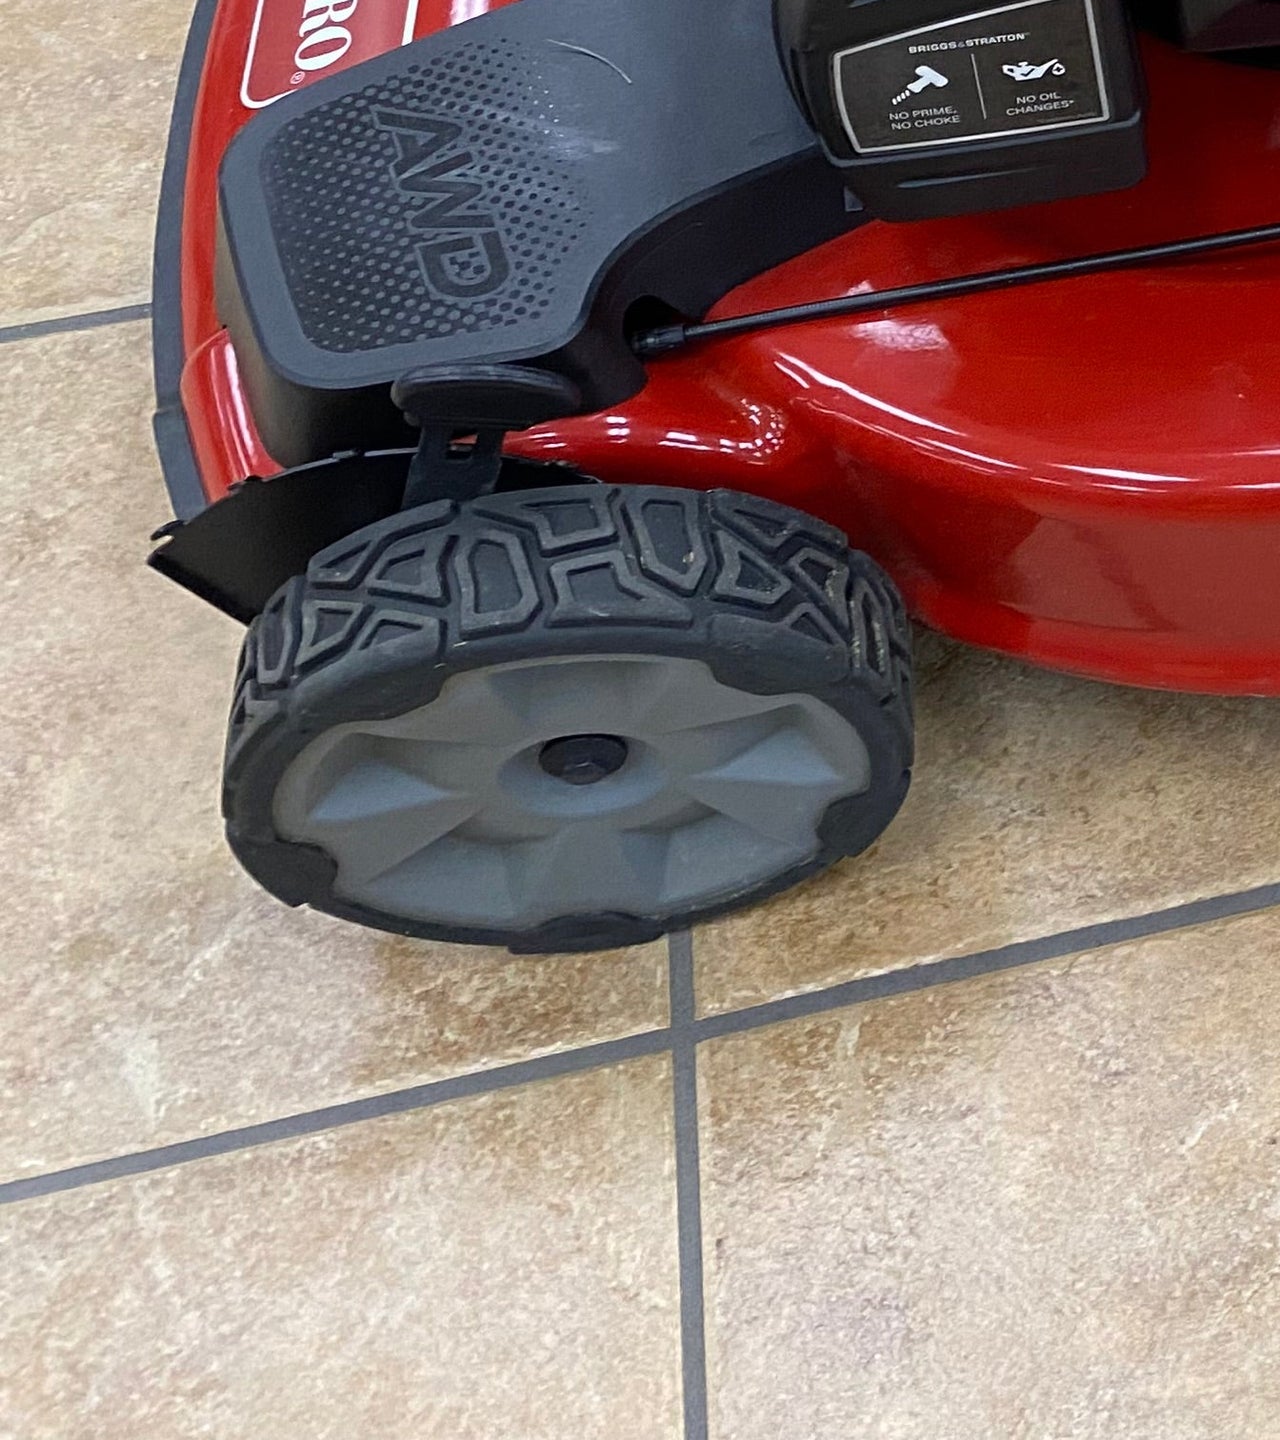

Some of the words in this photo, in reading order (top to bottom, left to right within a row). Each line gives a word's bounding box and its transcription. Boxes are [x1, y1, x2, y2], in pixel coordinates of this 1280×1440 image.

[1016, 94, 1037, 105] NO
[1039, 91, 1062, 102] OIL
[889, 110, 910, 122] NO
[891, 120, 912, 131] NO
[913, 114, 961, 129] CHOKE
[370, 105, 509, 300] AWD
